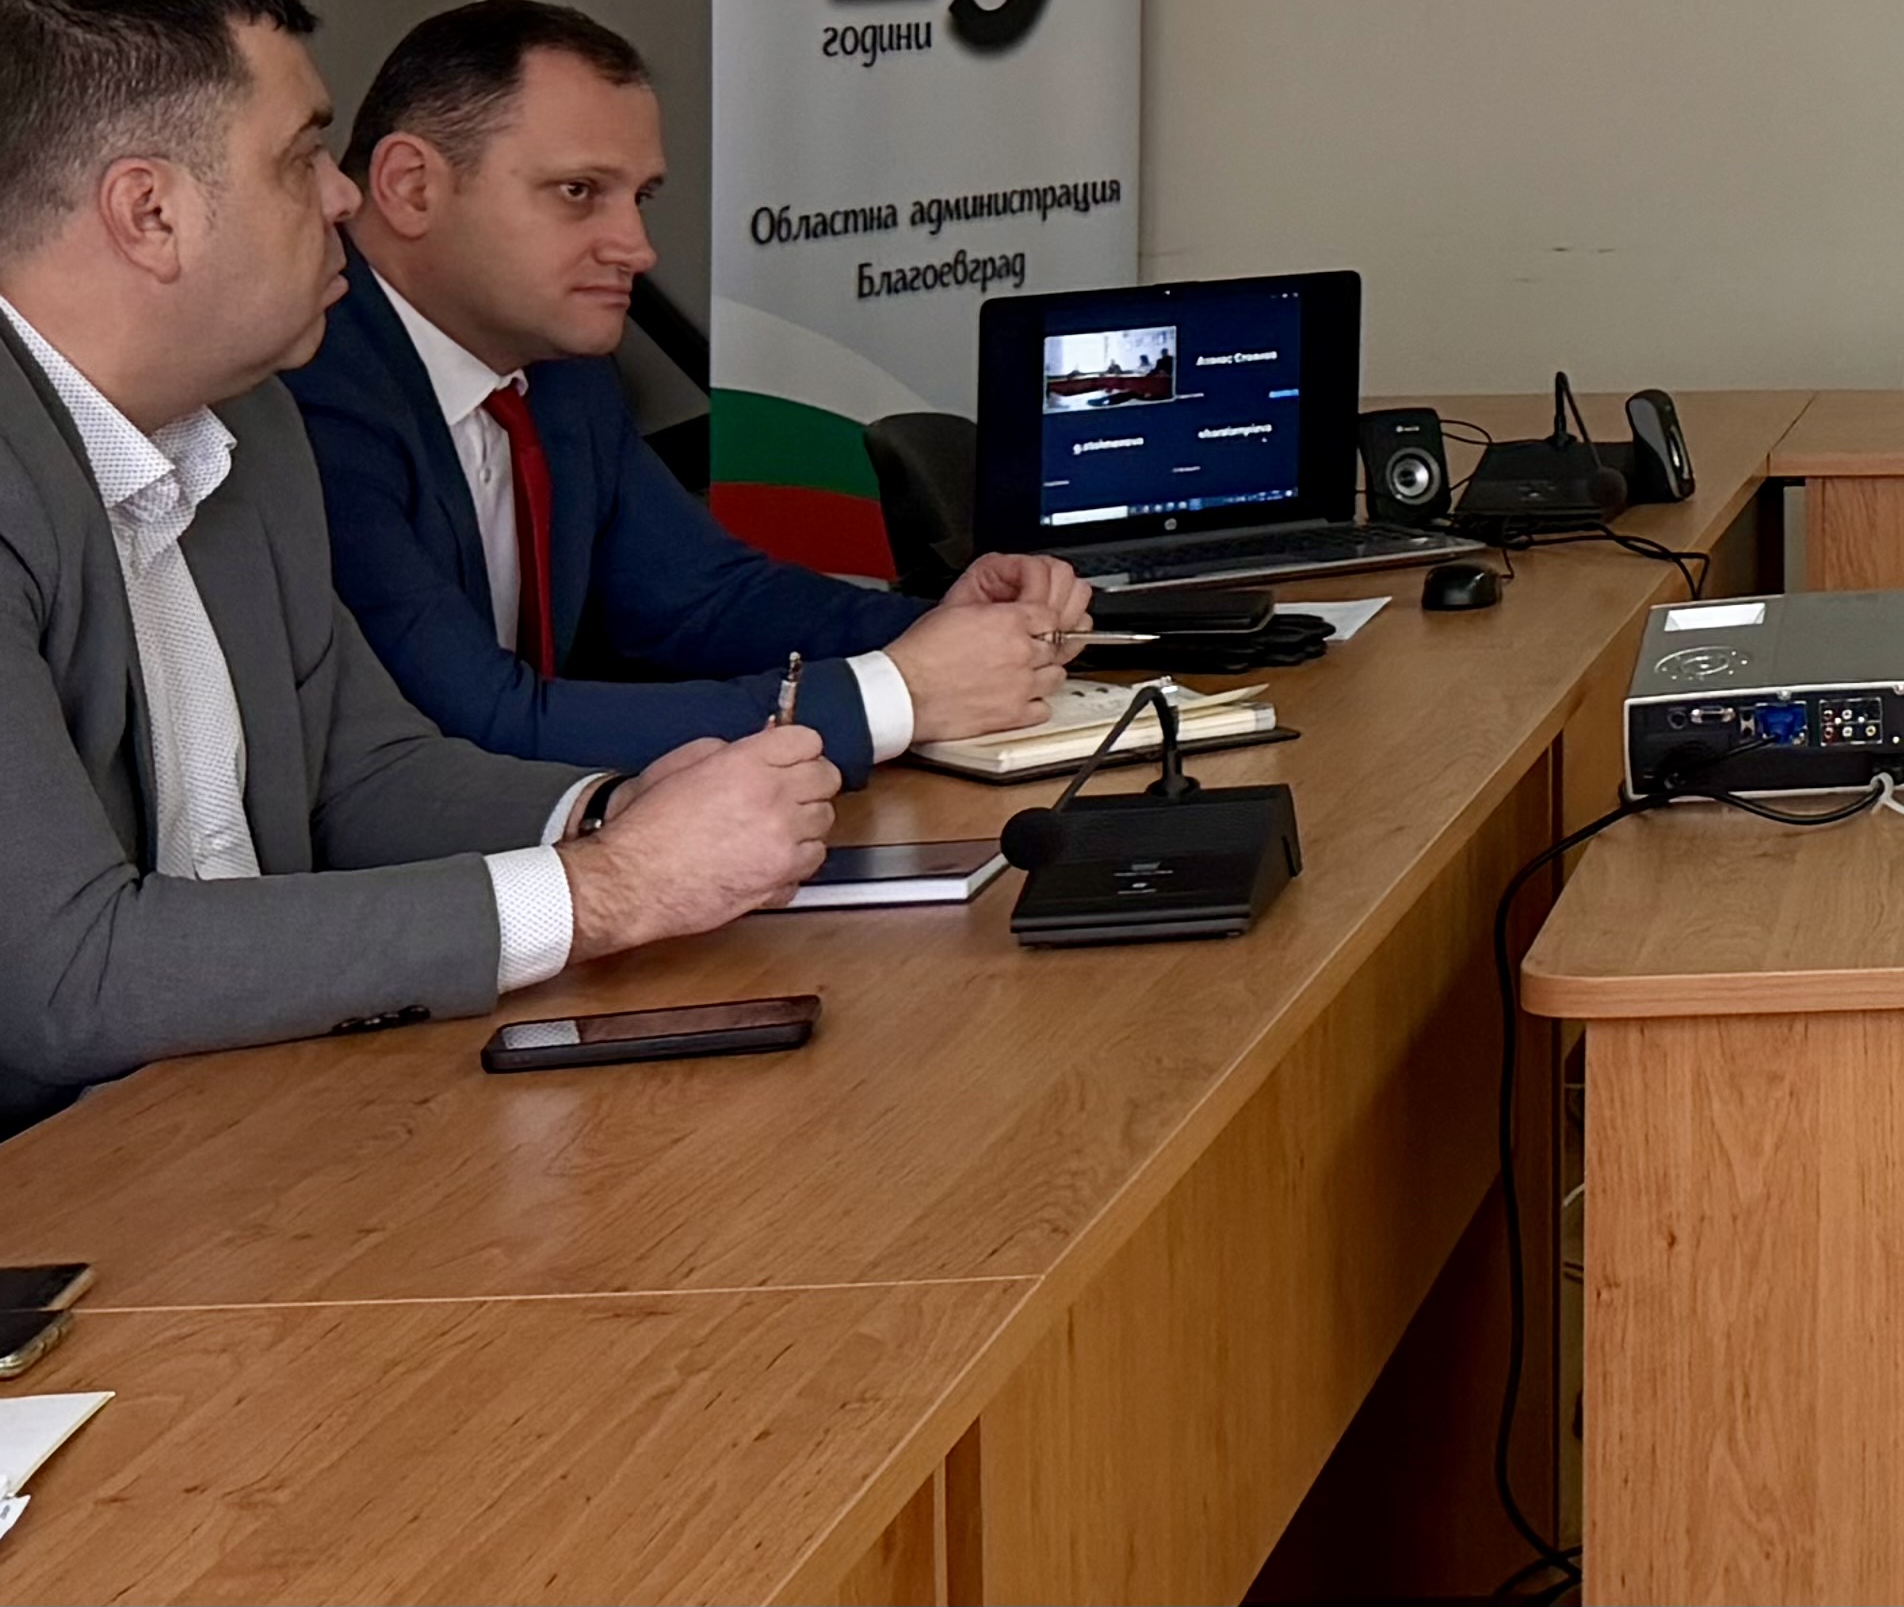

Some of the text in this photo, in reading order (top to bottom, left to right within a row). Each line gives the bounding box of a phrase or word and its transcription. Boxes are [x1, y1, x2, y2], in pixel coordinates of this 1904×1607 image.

[822, 19, 933, 68] години
[750, 178, 1121, 246] Областна администрация
[856, 248, 1026, 299] Благоевград
